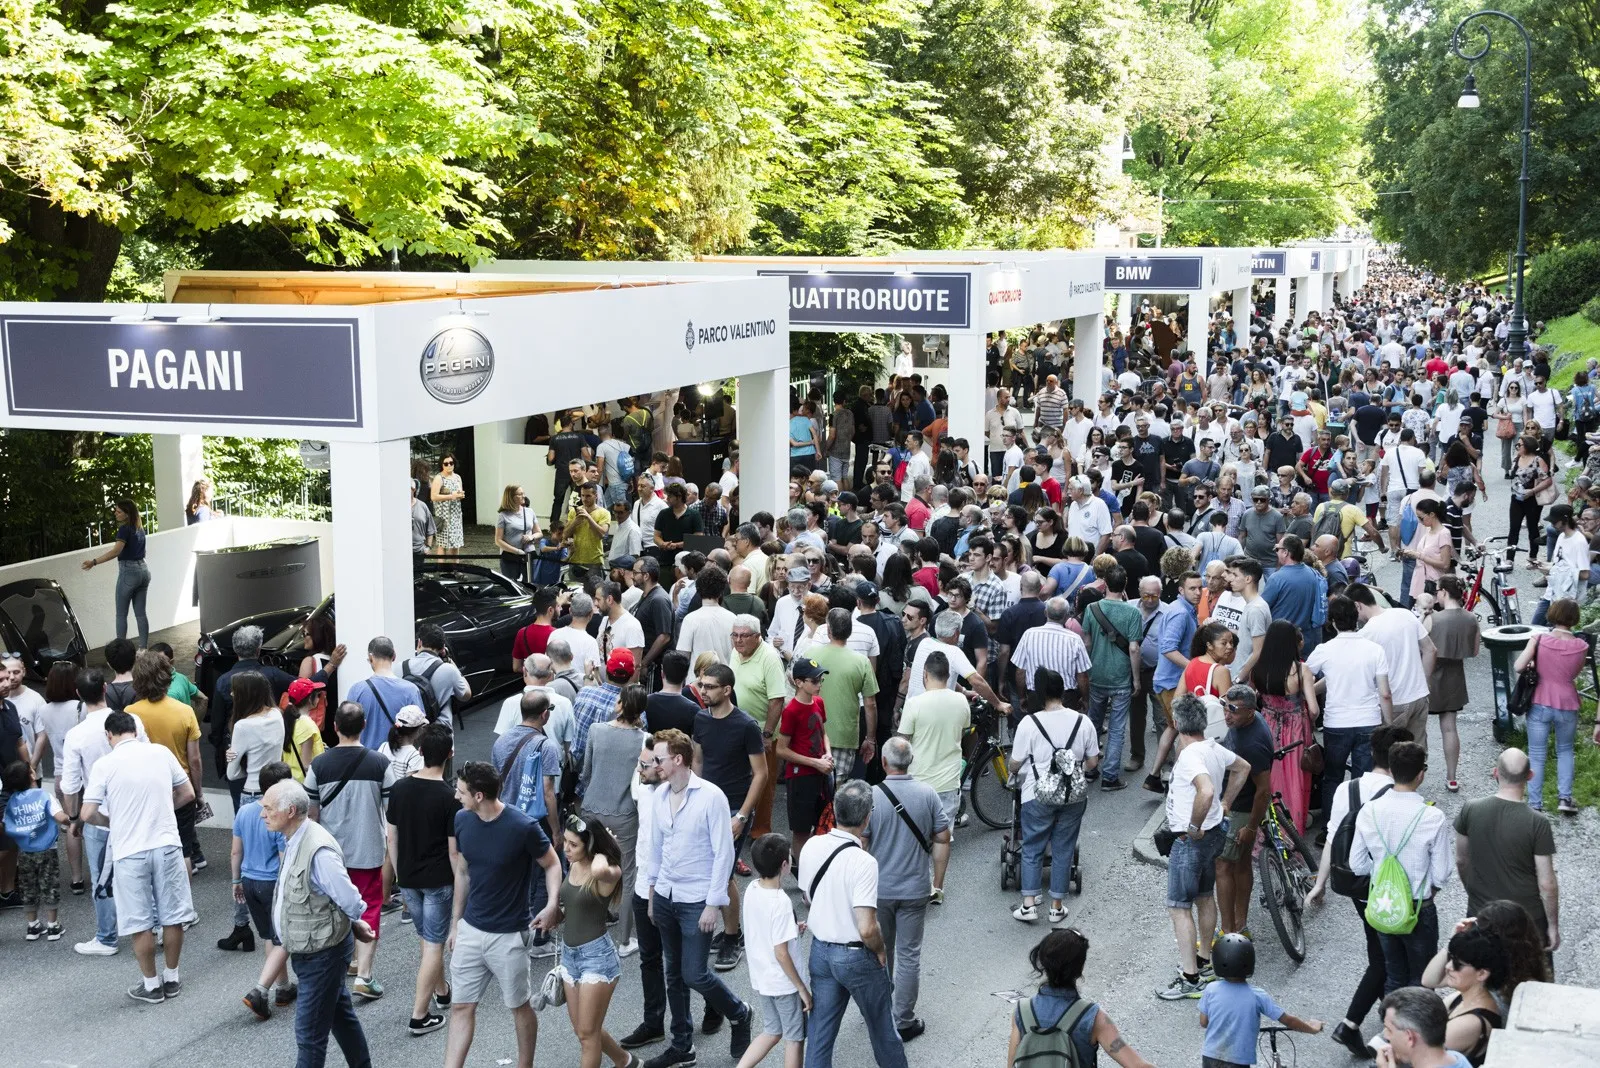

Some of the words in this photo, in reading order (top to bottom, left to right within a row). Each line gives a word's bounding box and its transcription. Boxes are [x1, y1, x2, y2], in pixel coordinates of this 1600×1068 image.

[1116, 266, 1152, 280] BMW
[788, 287, 950, 312] UATTRORUOTE
[698, 325, 728, 345] PARCO
[730, 319, 776, 340] VALENTINO
[107, 348, 244, 391] PAGANI
[425, 355, 490, 375] PAGANI
[13, 800, 45, 816] THINK
